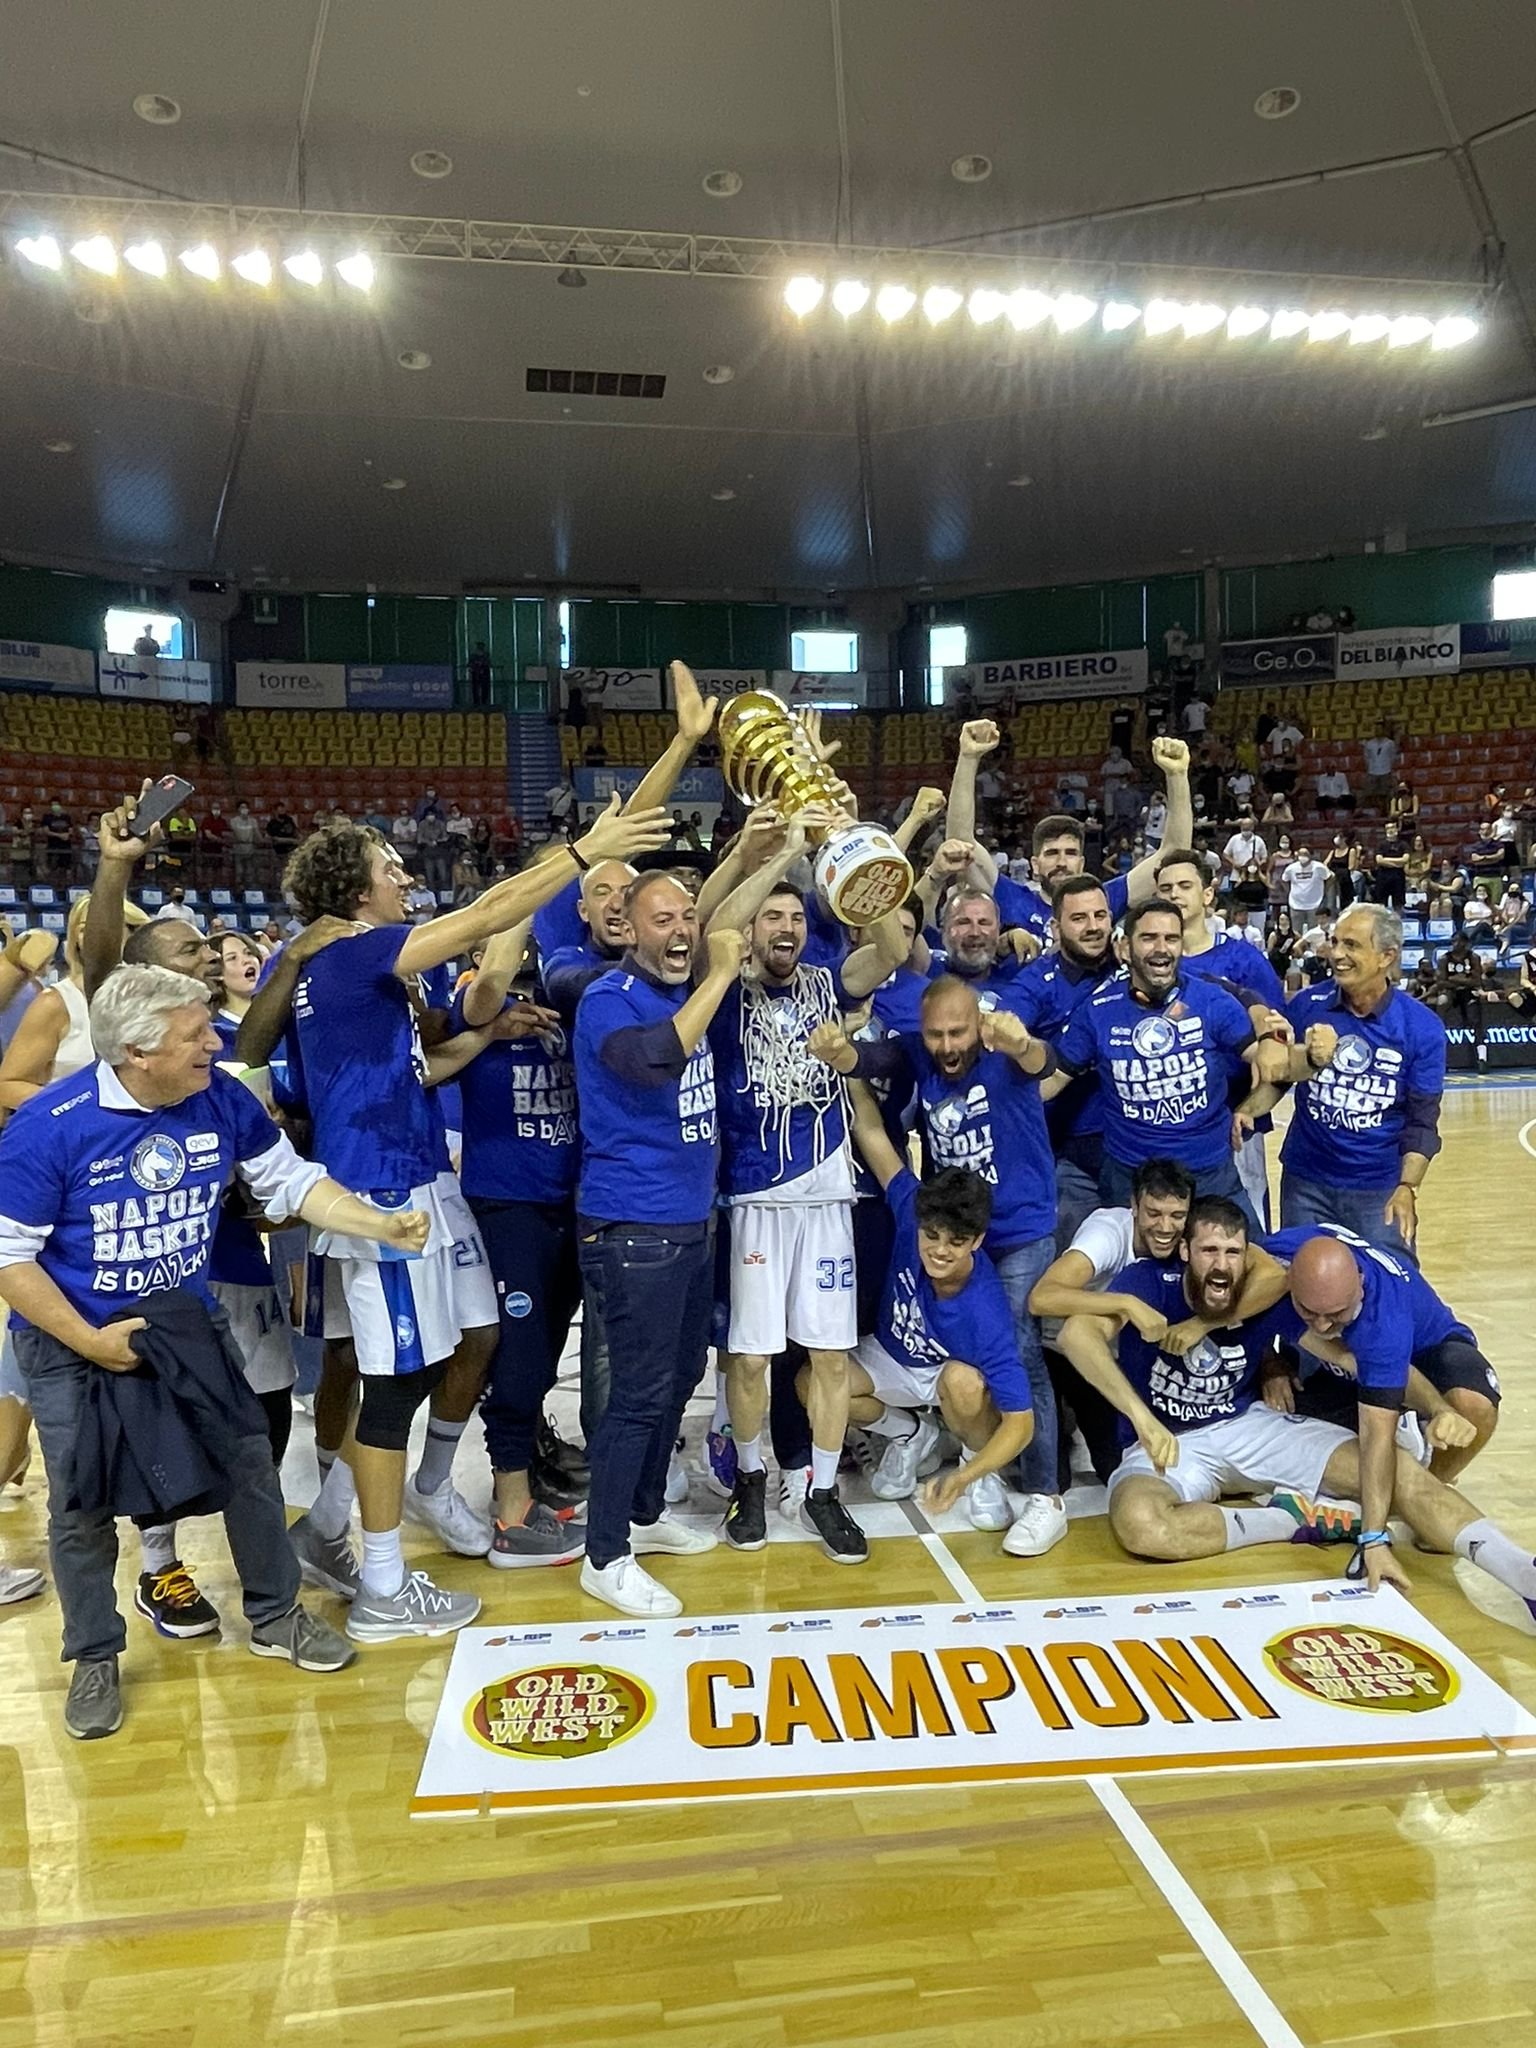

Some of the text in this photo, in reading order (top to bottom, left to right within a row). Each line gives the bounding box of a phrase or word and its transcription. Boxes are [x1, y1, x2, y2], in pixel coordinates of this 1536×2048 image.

[983, 656, 1118, 684] BARBIERO
[868, 863, 903, 887] OLD
[1111, 1049, 1206, 1081] NAPOLI
[1114, 1067, 1207, 1102] BASKET
[1123, 1101, 1139, 1118] is
[517, 1117, 536, 1138] is
[682, 1121, 699, 1143] is
[90, 1181, 219, 1233] NAPOLI
[93, 1211, 211, 1262] BASKET
[453, 1233, 487, 1270] 21
[93, 1265, 119, 1291] is
[816, 1256, 854, 1292] 32
[1152, 1356, 1244, 1391] NAPOLI
[1148, 1372, 1234, 1404] BASKET
[1292, 1632, 1382, 1657] OLD
[1293, 1652, 1416, 1678] WILD
[515, 1673, 608, 1697] OLD
[685, 1635, 1280, 1749] CAMPIONI
[1304, 1672, 1440, 1700] WEST
[500, 1693, 620, 1721] WILD
[489, 1714, 626, 1744] WEST
